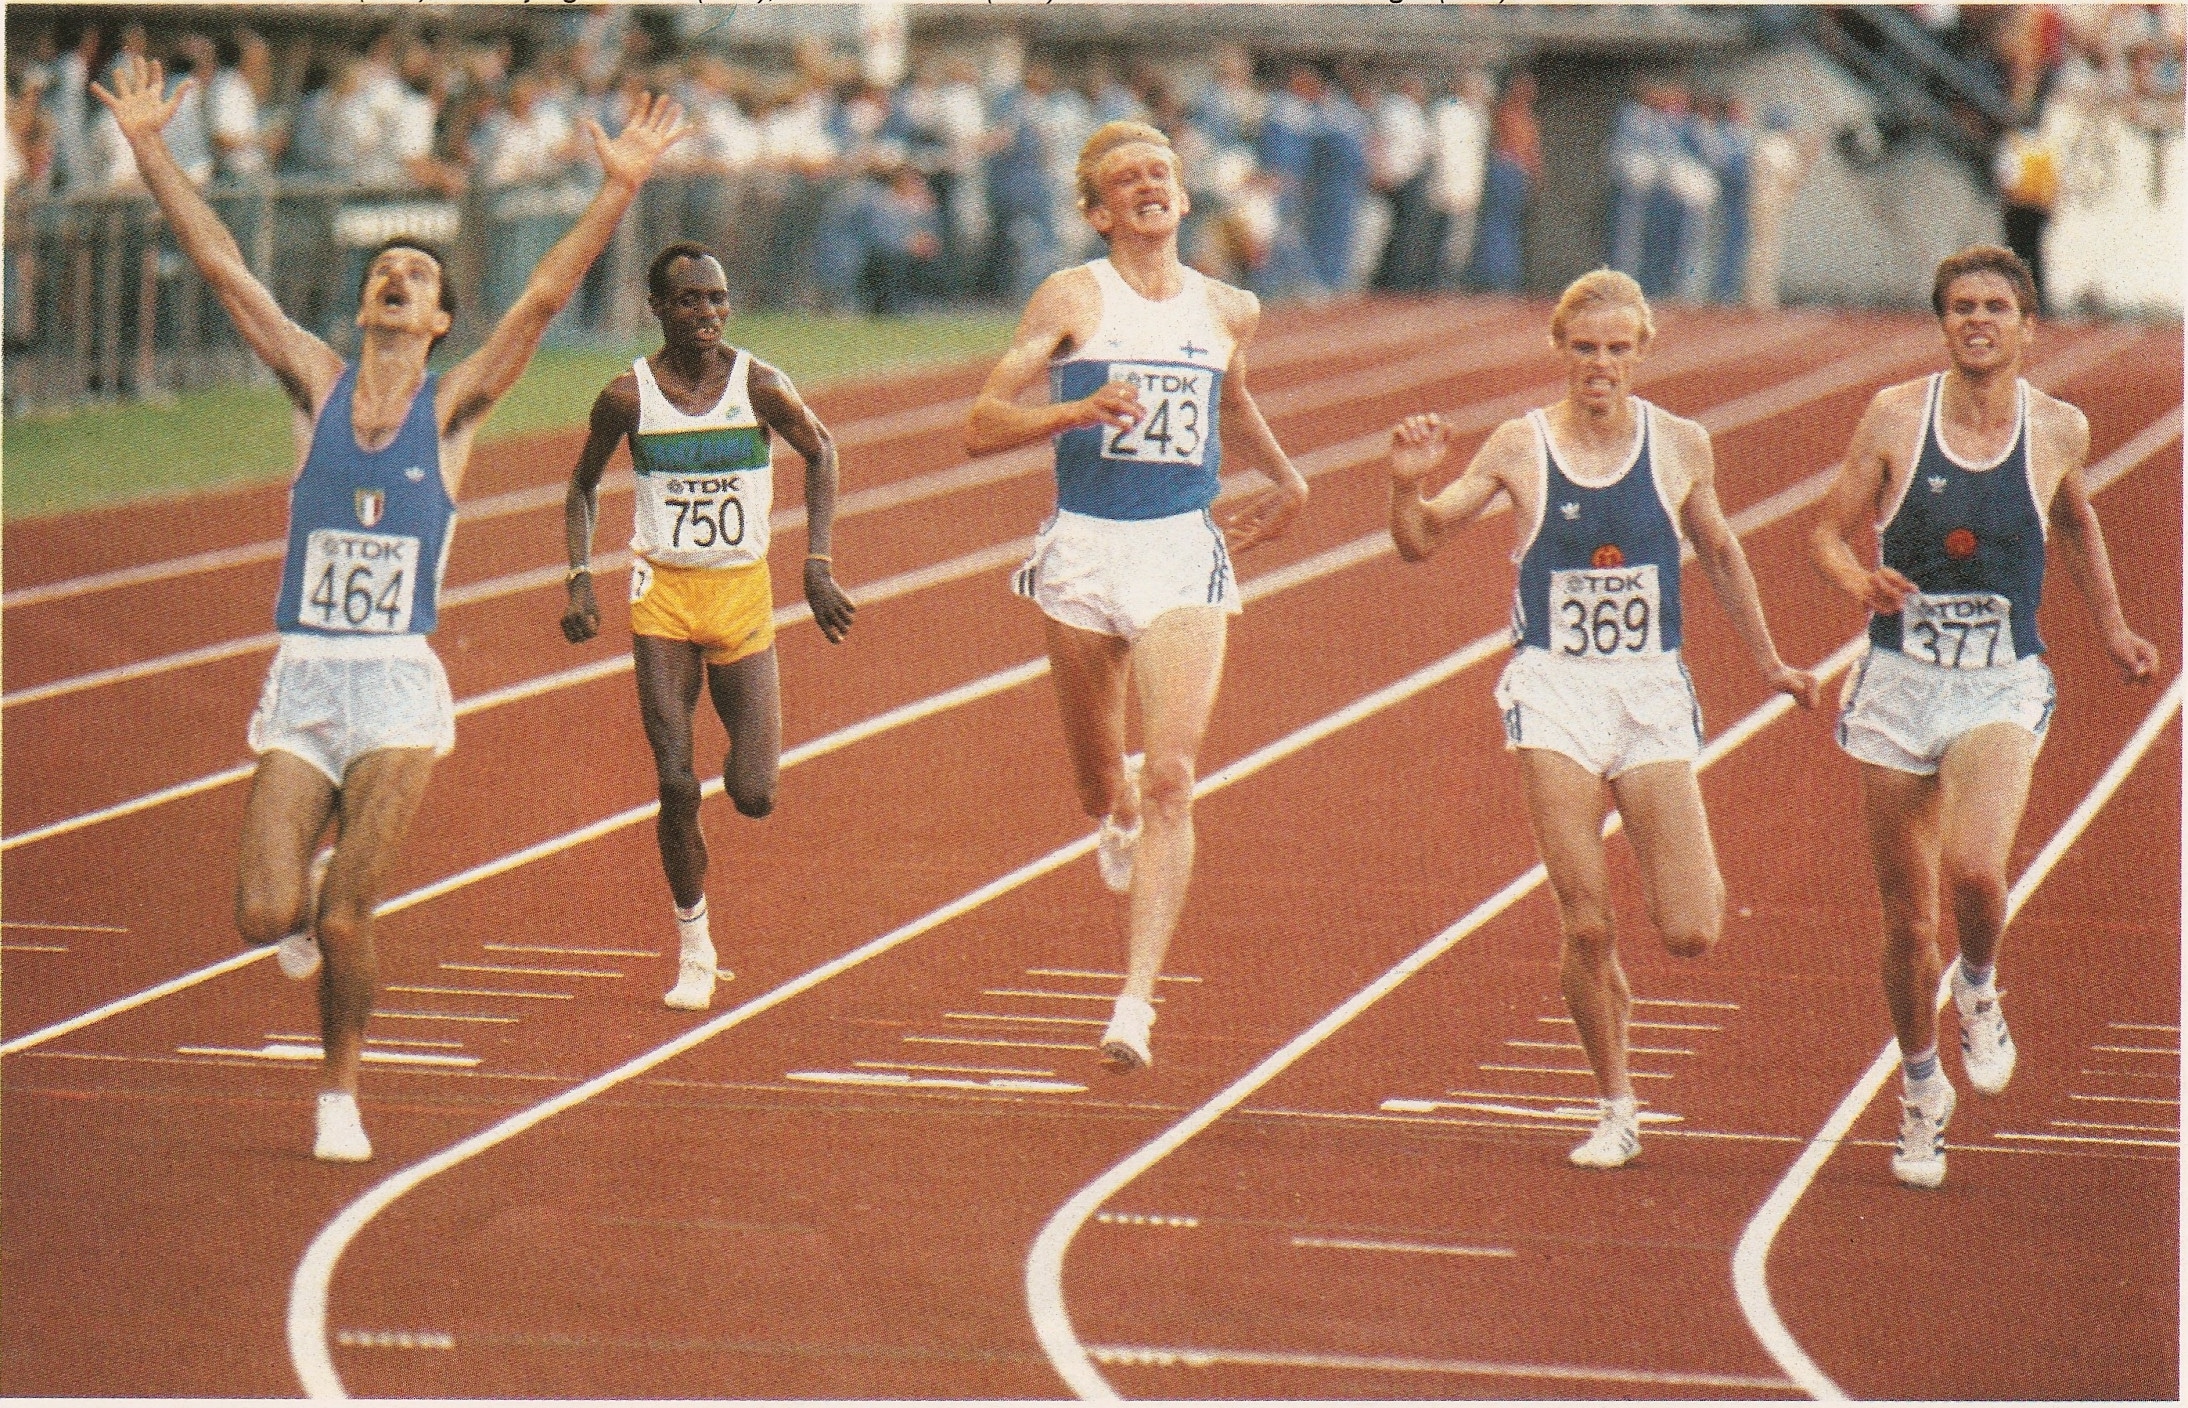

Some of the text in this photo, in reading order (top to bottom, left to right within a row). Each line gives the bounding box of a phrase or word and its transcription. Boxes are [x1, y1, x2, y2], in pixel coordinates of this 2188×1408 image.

[1143, 373, 1199, 394] TDK
[682, 477, 740, 494] TDK
[664, 497, 745, 547] 750
[342, 537, 404, 560] TDK
[1583, 572, 1644, 593] TDK
[310, 562, 404, 628] 464
[1932, 597, 1997, 619] TDK
[1561, 597, 1650, 656] 369
[1912, 618, 2001, 667] 377
